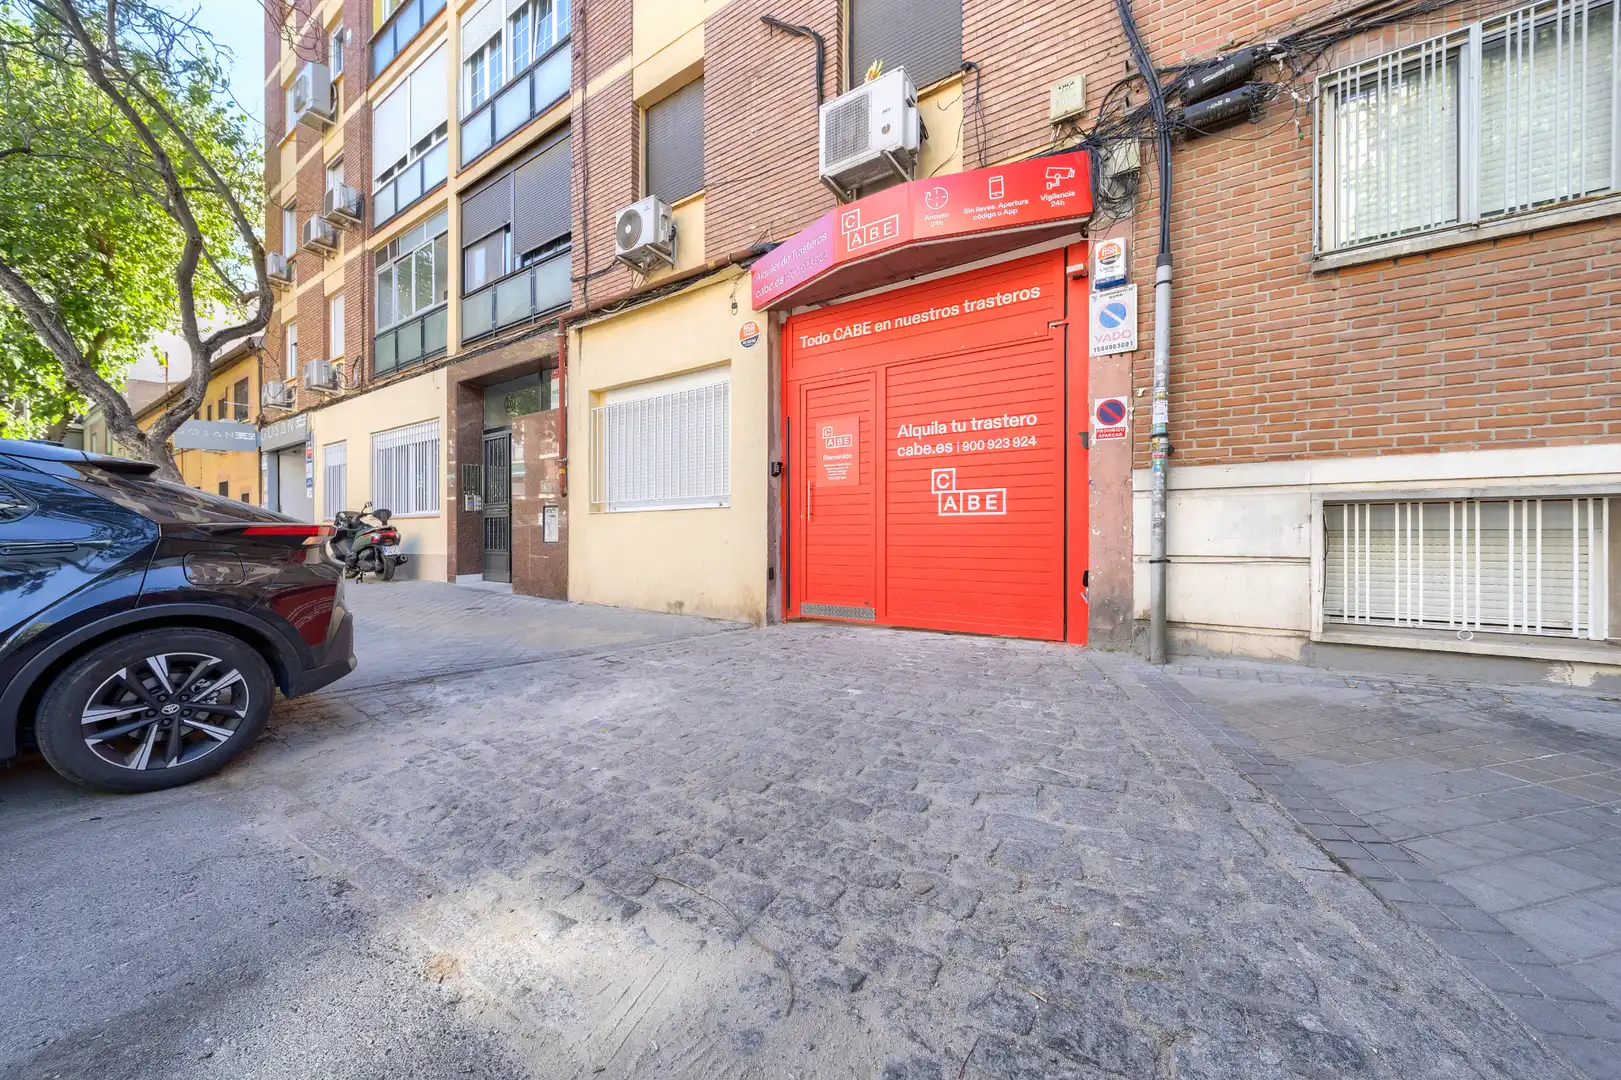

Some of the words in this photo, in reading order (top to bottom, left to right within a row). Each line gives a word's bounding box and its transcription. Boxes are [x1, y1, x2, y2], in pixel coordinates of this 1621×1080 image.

[1040, 190, 1076, 202] Vigilancia
[1050, 200, 1065, 208] 24h
[963, 206, 975, 215] Sin
[997, 199, 1029, 210] Apertura
[973, 210, 997, 221] código
[1003, 208, 1018, 217] App
[930, 220, 944, 228] 24h
[755, 262, 781, 283] Alquiler
[781, 255, 791, 265] de
[791, 232, 827, 260] Trasteros
[755, 275, 785, 299] cabe.es
[800, 331, 830, 349] Todo
[833, 321, 872, 342] CABE
[874, 319, 891, 333] en
[894, 304, 960, 329] nuestros
[963, 286, 1041, 314] trasteros
[1094, 329, 1132, 344] VADO
[897, 421, 947, 440] Alquila
[951, 419, 967, 433] tu
[971, 413, 1038, 431] trastero
[897, 442, 953, 457] cabe.es
[962, 440, 985, 452] 900
[987, 437, 1010, 450] 923
[1012, 435, 1037, 448] 924
